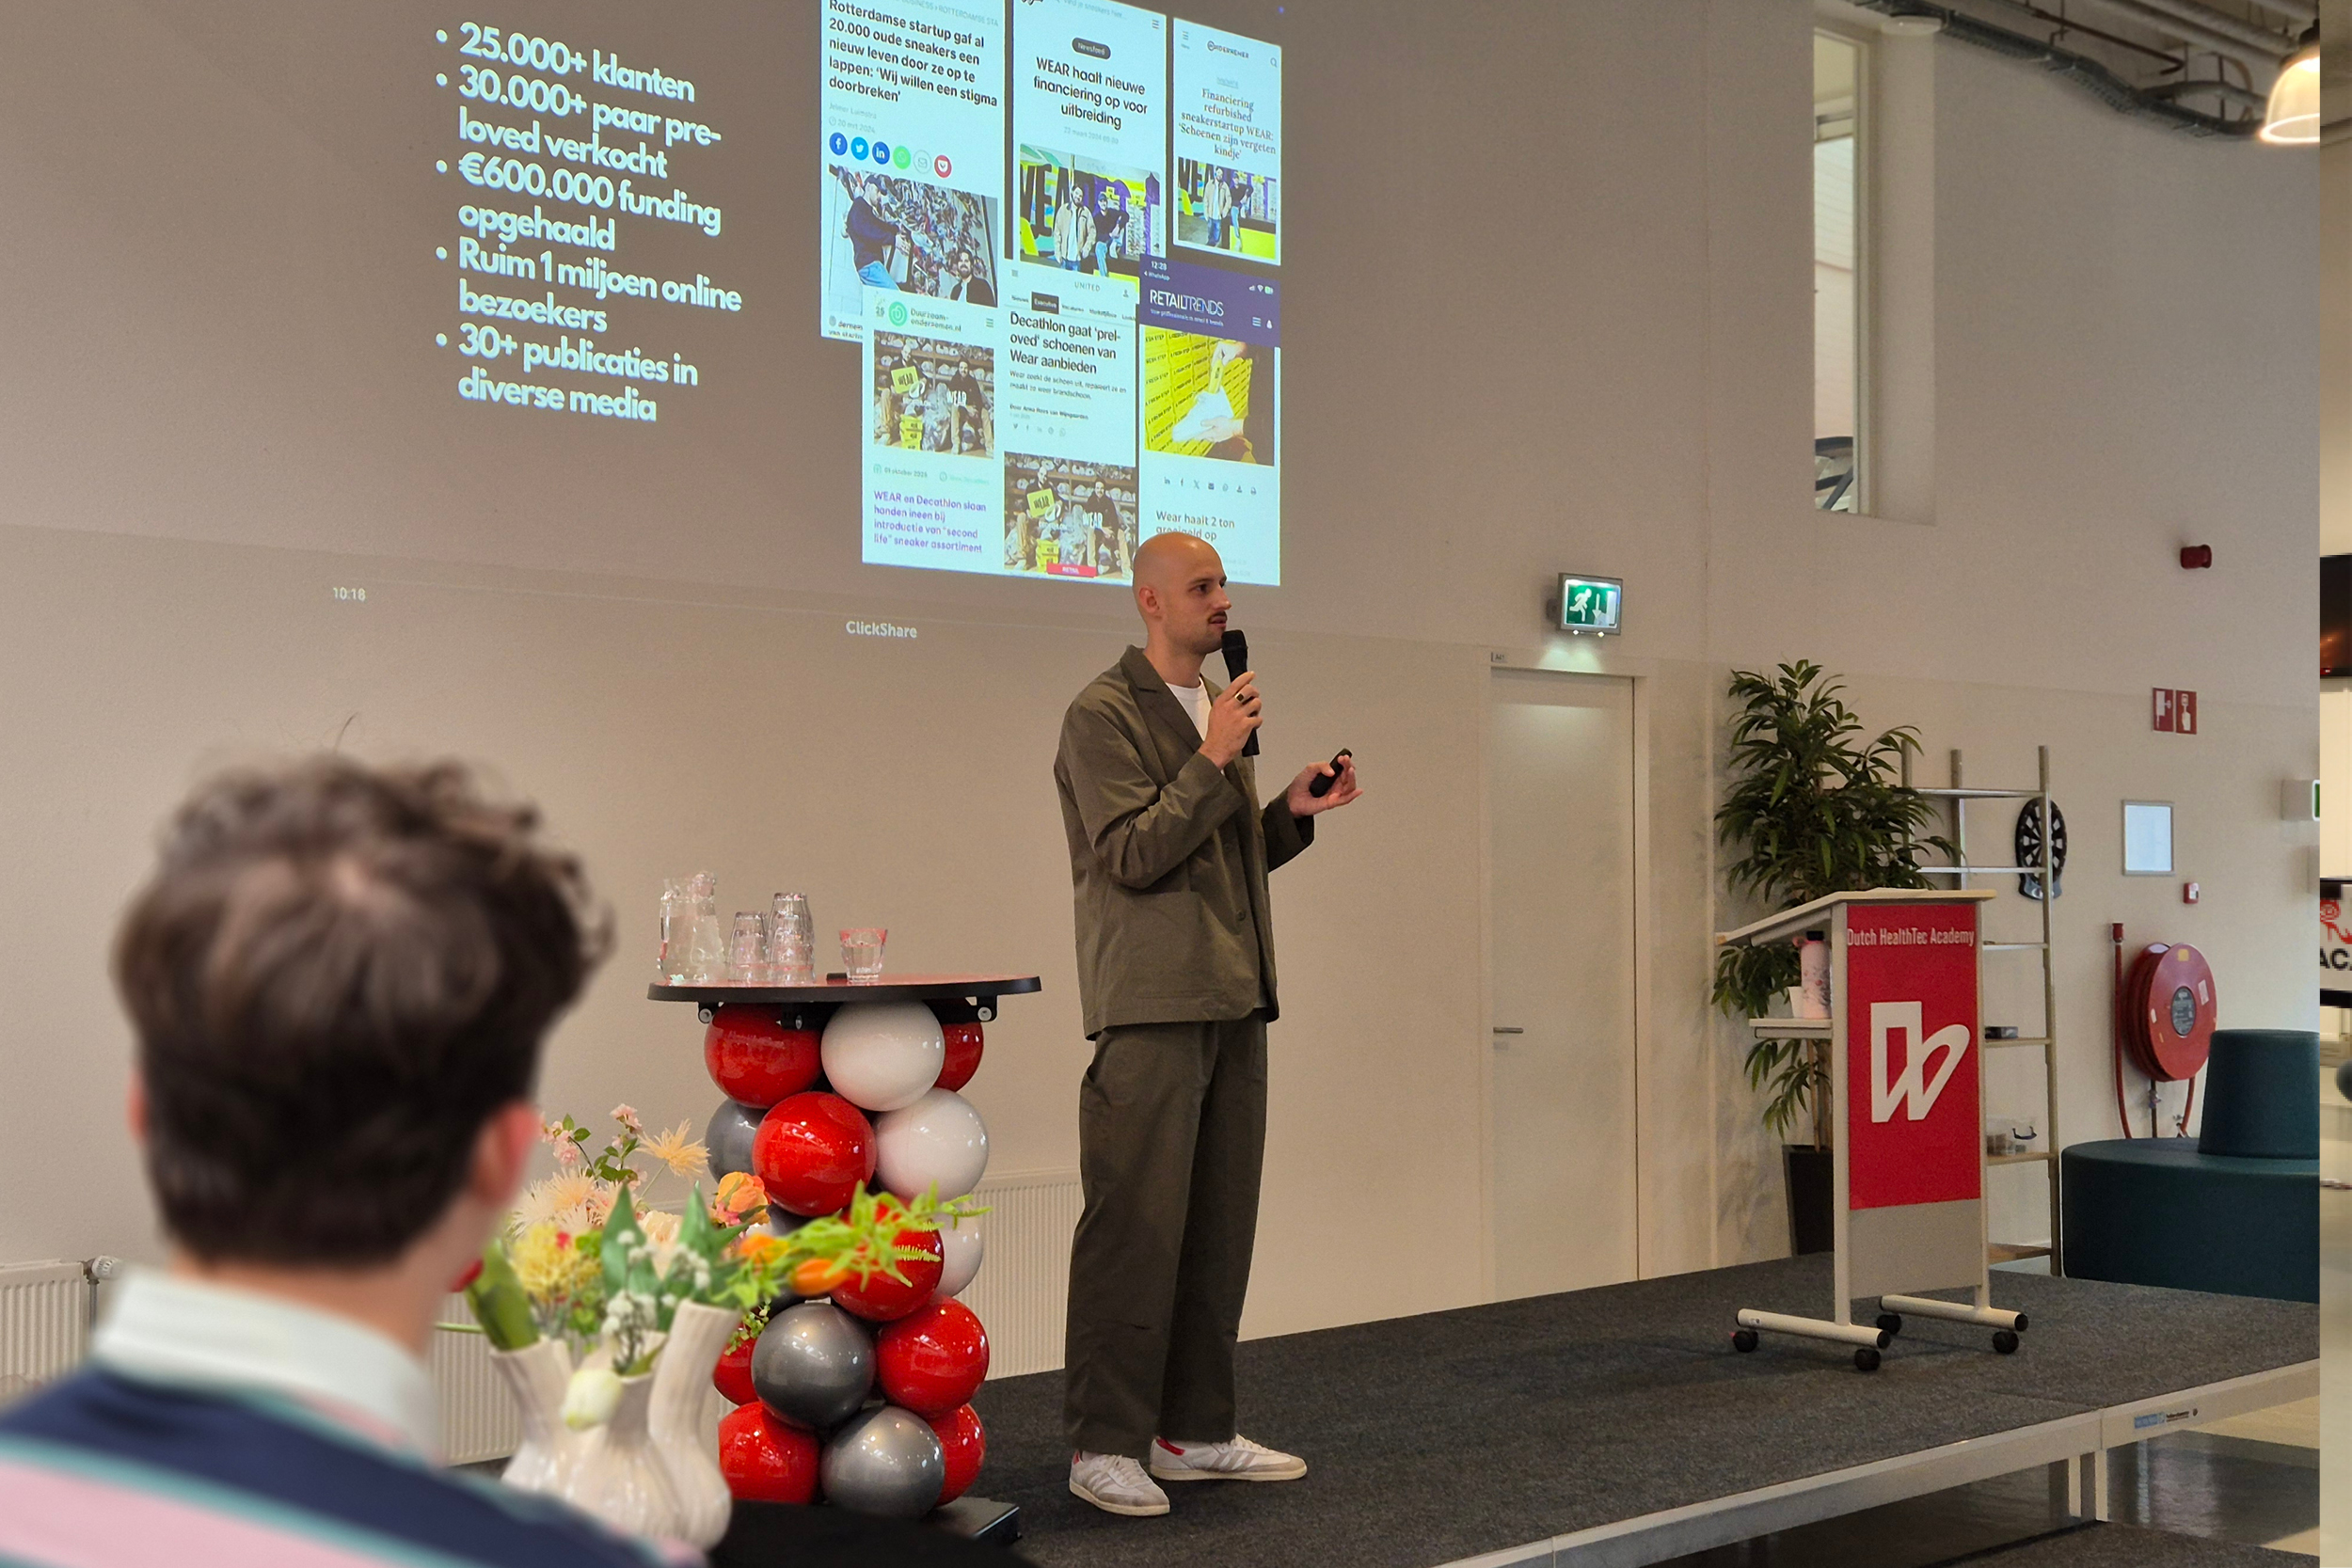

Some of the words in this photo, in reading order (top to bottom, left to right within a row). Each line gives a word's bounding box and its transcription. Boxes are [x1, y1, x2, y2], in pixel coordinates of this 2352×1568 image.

[829, 0, 906, 28] Rotterdamse
[909, 20, 951, 41] startup
[953, 32, 972, 45] gaf
[974, 36, 985, 48] al
[829, 17, 870, 39] 20.000
[873, 29, 902, 47] oude
[904, 38, 957, 60] sneakers
[959, 52, 980, 66] een
[459, 21, 587, 74] 25.000+
[593, 49, 695, 102] klanten
[829, 38, 866, 56] nieuw
[866, 45, 898, 64] leven
[901, 55, 929, 71] door
[930, 63, 945, 75] ze
[946, 67, 961, 83] op
[963, 70, 976, 83] te
[829, 55, 874, 77] lappen:
[900, 74, 934, 92] willen
[936, 83, 958, 98] een
[960, 88, 998, 107] stigma
[1036, 56, 1070, 77] WEAR
[1073, 66, 1103, 85] haalt
[1105, 75, 1146, 95] nieuwe
[459, 64, 587, 117] 30.000+
[593, 103, 660, 135] paar
[665, 118, 722, 147] pre-
[1034, 75, 1102, 107] financiering
[1104, 95, 1120, 110] op
[1123, 99, 1148, 115] voor
[1202, 88, 1254, 111] Financiering
[1061, 103, 1121, 131] uitbreiding
[1181, 112, 1244, 135] sneakerstartup
[1247, 126, 1273, 141] WEAR:
[1204, 103, 1251, 122] refurbished
[459, 105, 540, 153] loved
[544, 132, 668, 179] verkocht
[1223, 135, 1239, 146] zijn
[1240, 140, 1276, 154] vergeten
[458, 151, 614, 209] €600.000
[618, 179, 722, 236] funding
[459, 205, 615, 251] opgehaald
[459, 236, 535, 280] Ruim
[540, 250, 552, 282] 1
[558, 257, 658, 300] miljoen
[661, 274, 742, 311] online
[1074, 281, 1101, 292] UNITED
[459, 277, 608, 333] bezoekers
[1150, 289, 1224, 317] RETAILTRENDS
[1010, 311, 1066, 333] Decathlon
[1069, 325, 1091, 338] gaat
[459, 323, 517, 359] 30+
[524, 335, 669, 382] publicaties
[673, 352, 698, 386] in
[1010, 350, 1039, 365] Wear
[1041, 356, 1097, 374] aanbieden
[1043, 338, 1095, 356] schoenen
[1097, 348, 1117, 359] van
[459, 365, 564, 410] diverse
[569, 386, 657, 421] media
[874, 491, 901, 502] WEAR
[916, 495, 961, 510] Decathlon
[963, 500, 987, 512] slaan
[874, 505, 907, 517] handen
[909, 509, 933, 520] ineen
[934, 512, 946, 523] bij
[874, 519, 924, 533] introductie
[925, 526, 941, 535] van
[1156, 510, 1182, 523] Wear
[1184, 514, 1209, 526] haalt
[1211, 516, 1216, 527] 2
[1219, 518, 1235, 529] ton
[894, 536, 929, 547] sneaker
[931, 540, 982, 553] assortiment
[1205, 531, 1217, 542] op
[846, 620, 917, 639] ClickShare
[1847, 928, 1877, 946] Dutch
[1880, 927, 1928, 945] HealthTec
[1930, 927, 1975, 947] Academy
